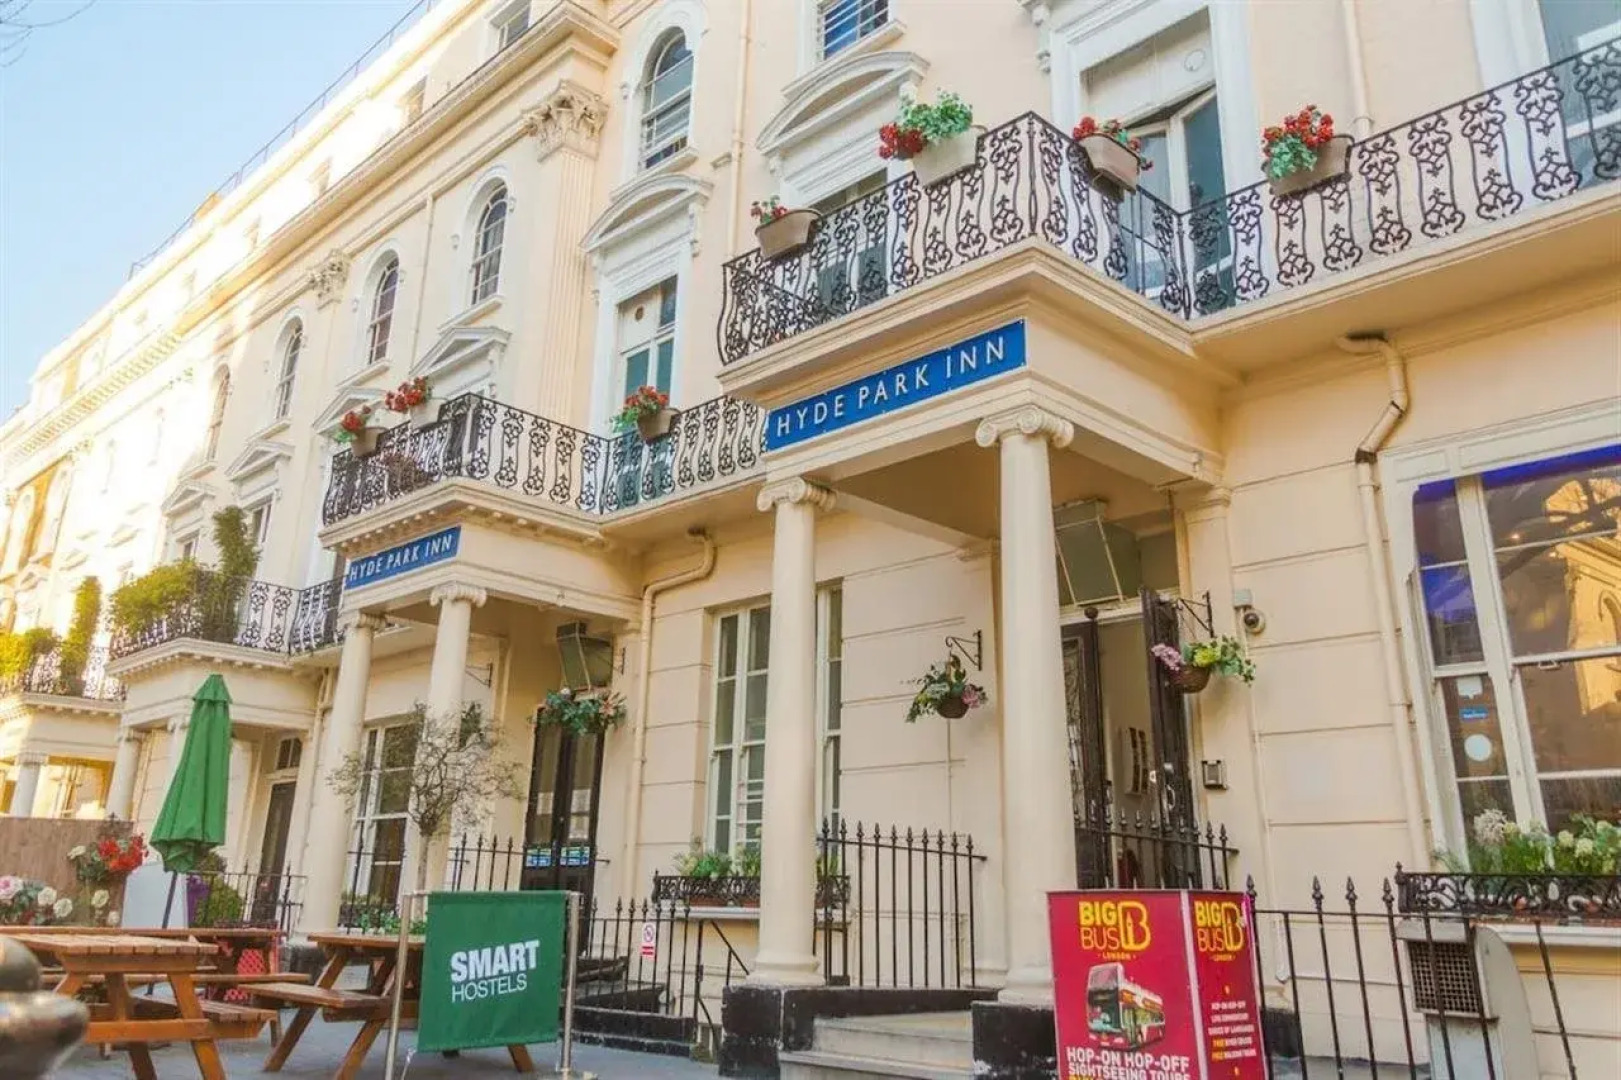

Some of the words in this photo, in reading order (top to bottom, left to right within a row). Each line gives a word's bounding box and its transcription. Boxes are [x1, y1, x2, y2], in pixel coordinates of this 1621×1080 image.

[776, 395, 845, 437] HYDE
[858, 364, 929, 409] PARK
[945, 336, 1004, 379] INN
[350, 556, 382, 581] HYDE
[386, 545, 420, 570] PARK
[425, 534, 452, 557] INN
[1079, 901, 1118, 926] BIG
[1194, 901, 1221, 928] BIG
[1080, 927, 1120, 950] BUS
[1197, 928, 1226, 952] BUS
[451, 940, 540, 983] SMART
[452, 973, 528, 1003] HOSTELS
[1066, 1046, 1121, 1067] HOP-ON
[1124, 1052, 1190, 1073] HOP-OFF
[1068, 1062, 1147, 1080] SIGHTSEEING
